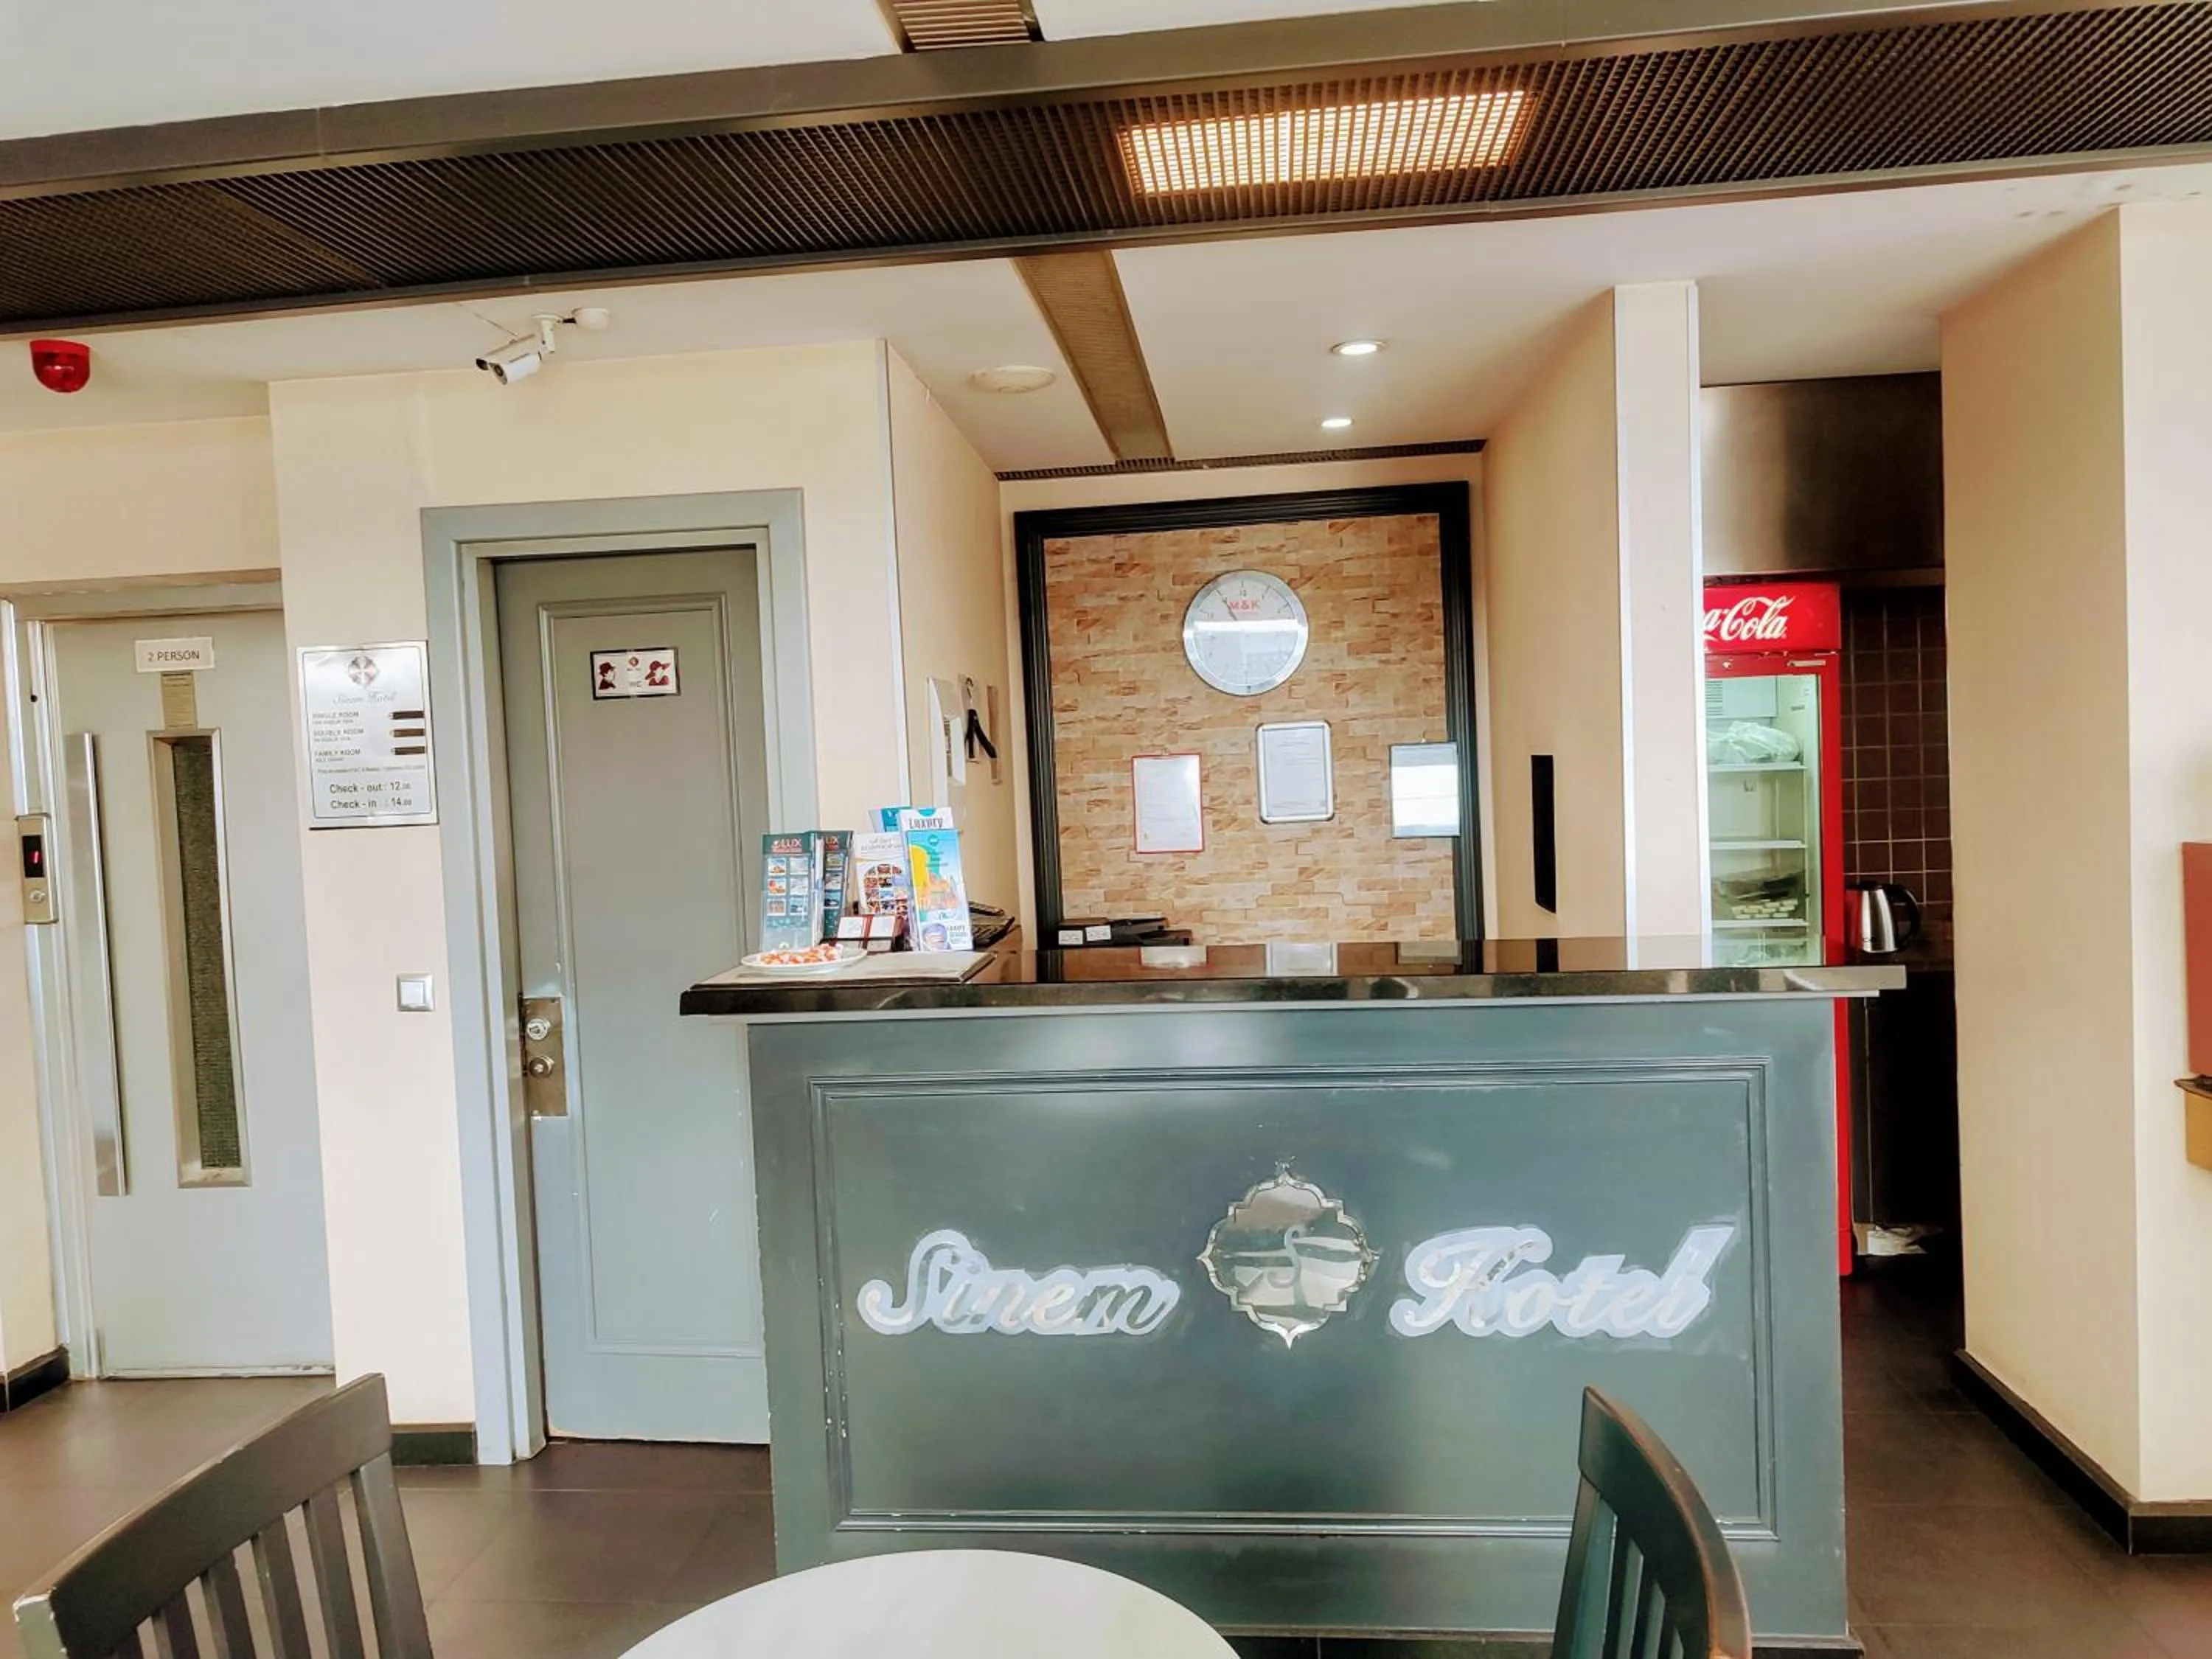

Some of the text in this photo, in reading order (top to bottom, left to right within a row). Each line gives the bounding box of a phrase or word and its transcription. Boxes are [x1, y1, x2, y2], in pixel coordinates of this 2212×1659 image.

[1703, 595, 1795, 641] a-Cola
[147, 650, 200, 662] 2 PERSON
[330, 783, 359, 794] Check
[330, 799, 360, 809] Check
[858, 1229, 1180, 1335] Sinem
[1391, 1222, 1735, 1338] Hotel
